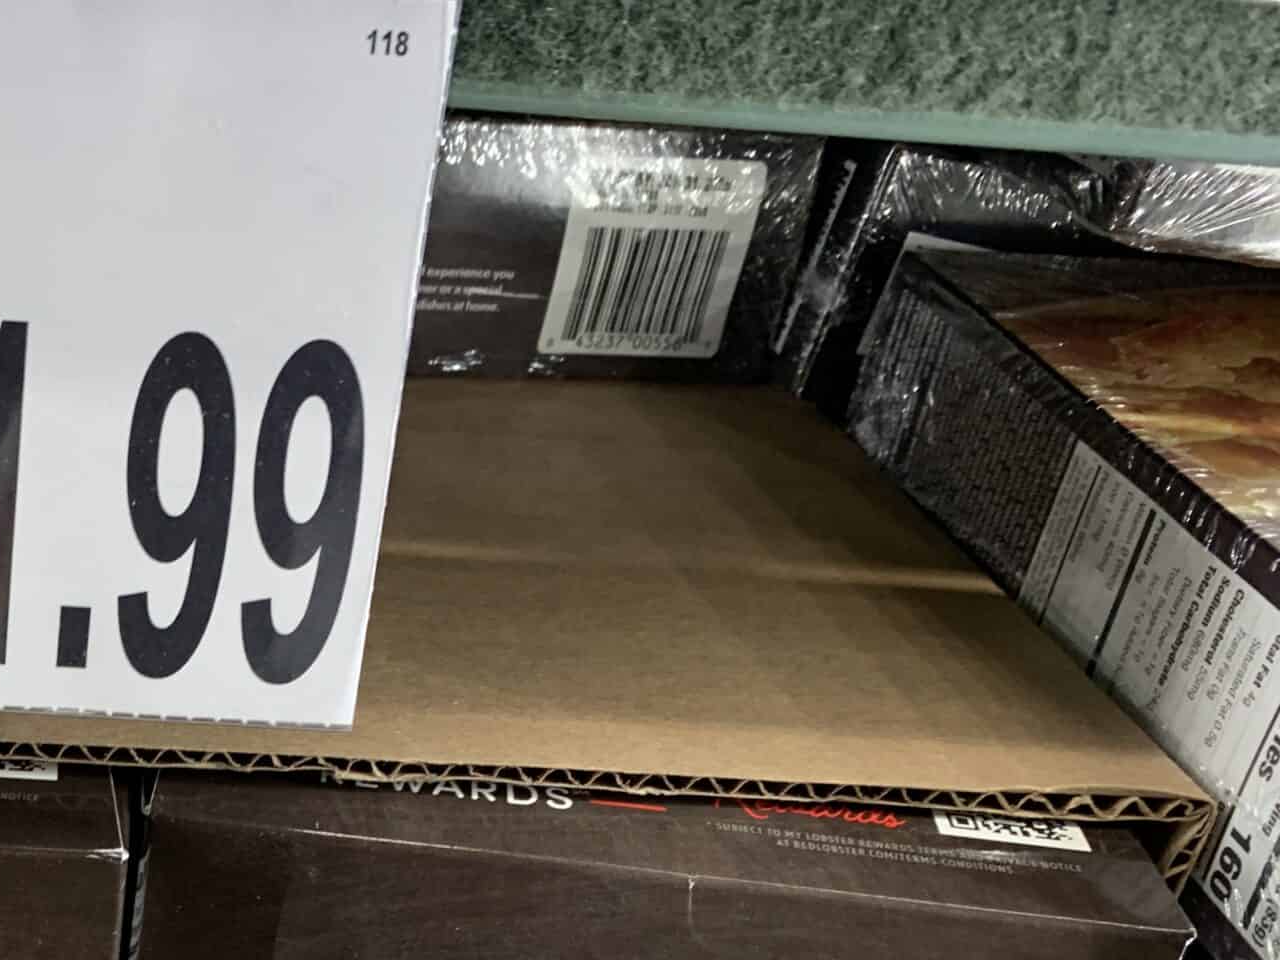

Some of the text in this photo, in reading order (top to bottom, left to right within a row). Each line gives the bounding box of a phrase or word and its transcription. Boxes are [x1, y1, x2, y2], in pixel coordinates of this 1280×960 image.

[367, 31, 409, 57] 118
[494, 271, 514, 280] you
[1156, 563, 1216, 687] Total Carbohydrate
[1201, 574, 1231, 629] Sodium
[1203, 587, 1244, 665] Cholesterol
[1210, 826, 1254, 901] 160
